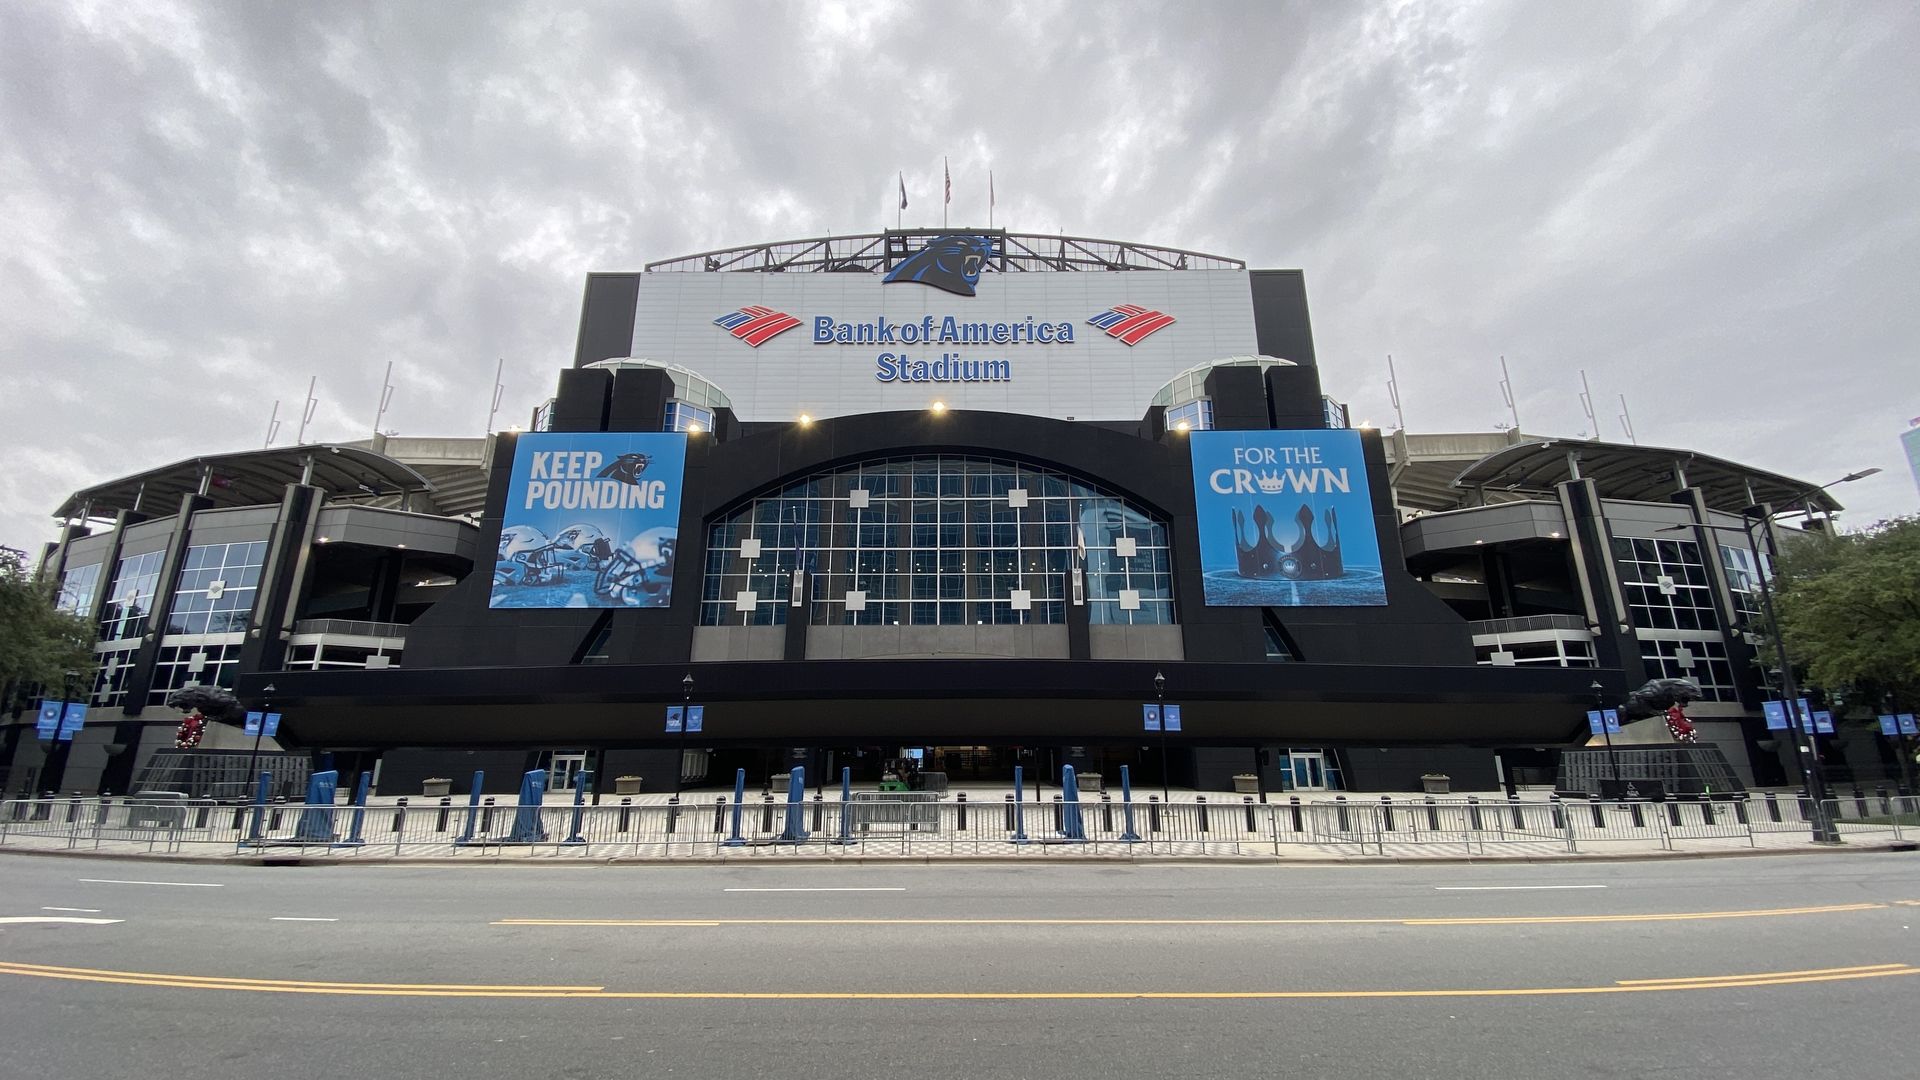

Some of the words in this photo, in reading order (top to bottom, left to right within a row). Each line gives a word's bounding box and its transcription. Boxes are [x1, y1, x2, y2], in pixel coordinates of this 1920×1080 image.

[813, 316, 896, 345] Bank
[900, 315, 937, 345] of
[938, 315, 1075, 344] America
[876, 353, 1011, 382] Stadium
[531, 451, 603, 479] KEEP
[1235, 447, 1278, 465] FOR
[1280, 447, 1322, 464] THE
[525, 480, 666, 510] POUNDING
